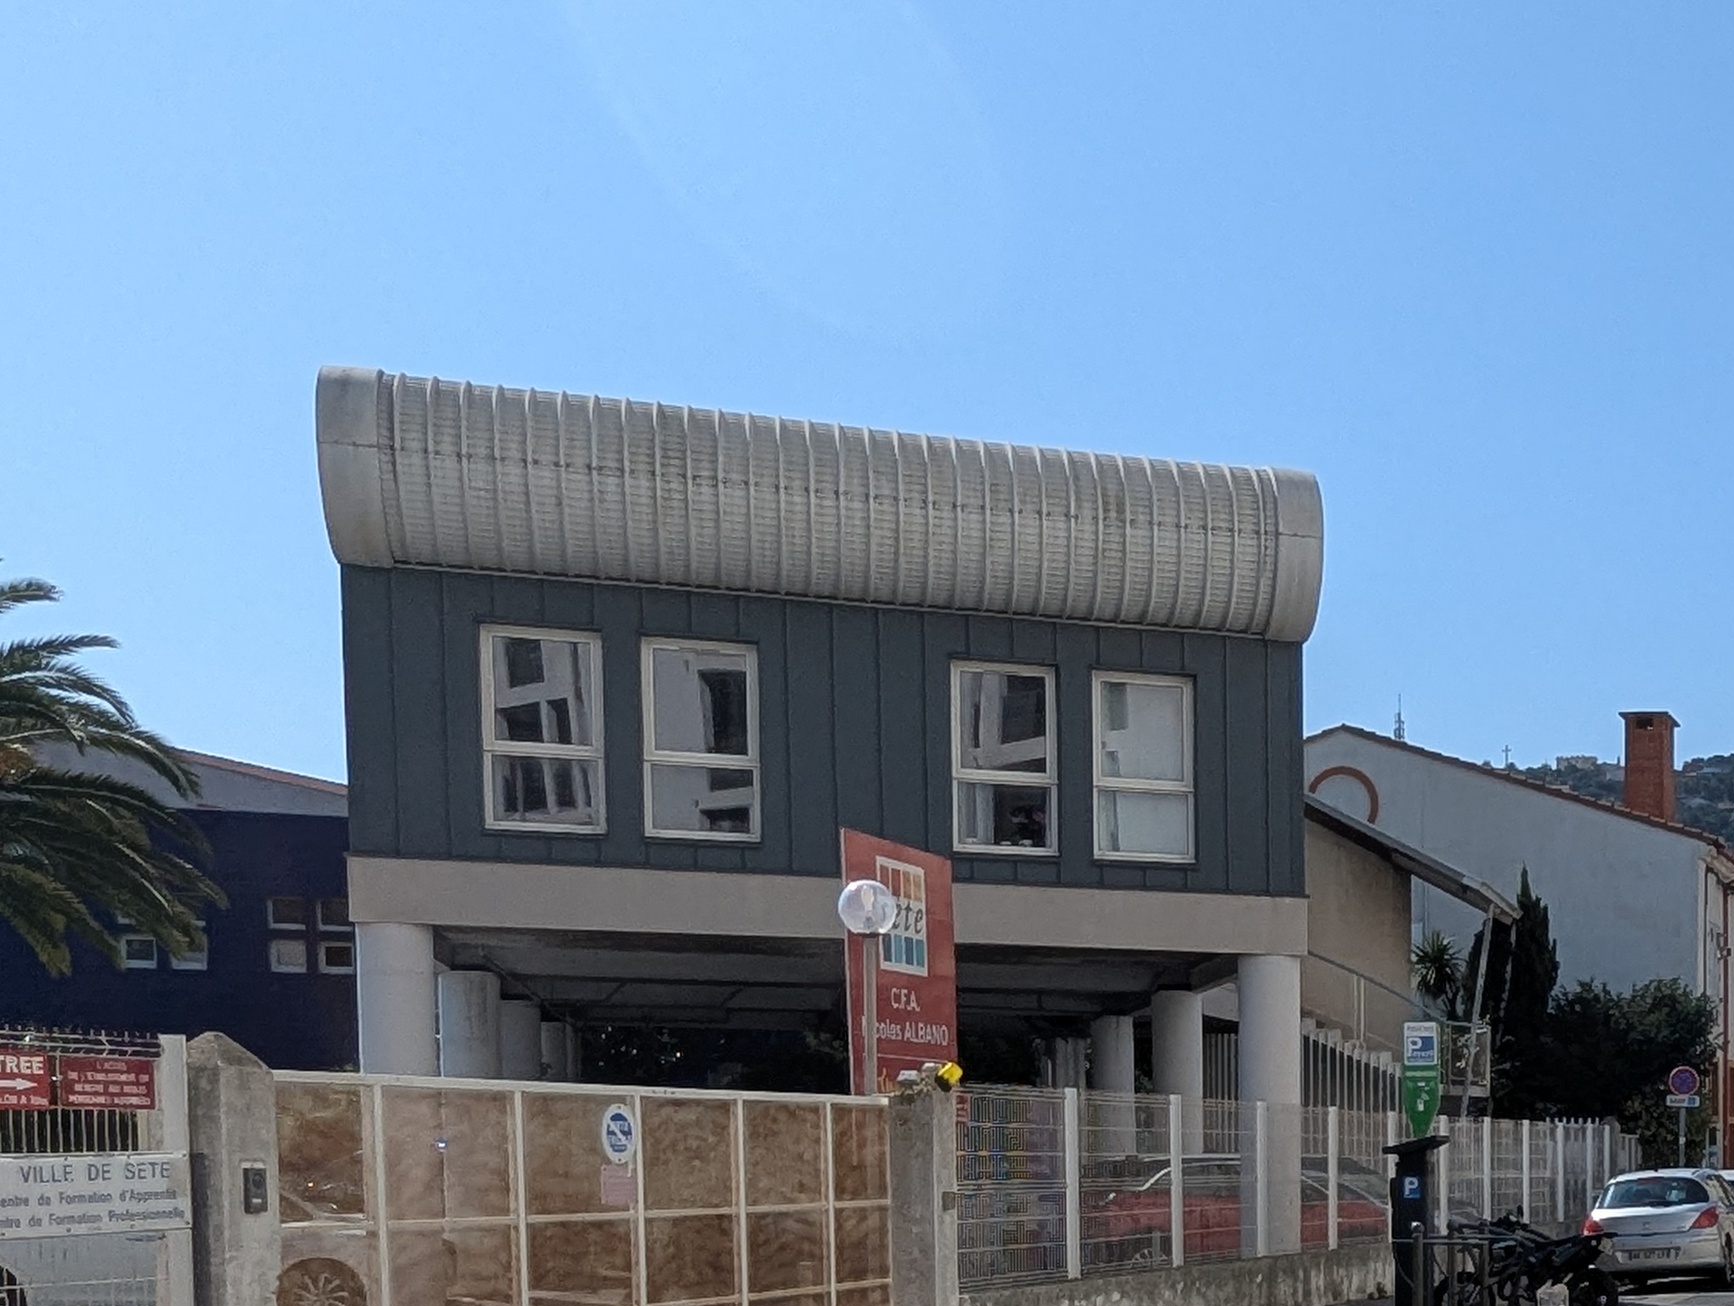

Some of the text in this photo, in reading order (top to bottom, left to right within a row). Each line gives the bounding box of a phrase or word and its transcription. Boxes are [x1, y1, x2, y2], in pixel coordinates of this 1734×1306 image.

[904, 1021, 948, 1046] ALBANO
[20, 1161, 170, 1184] VILLE DE SETE
